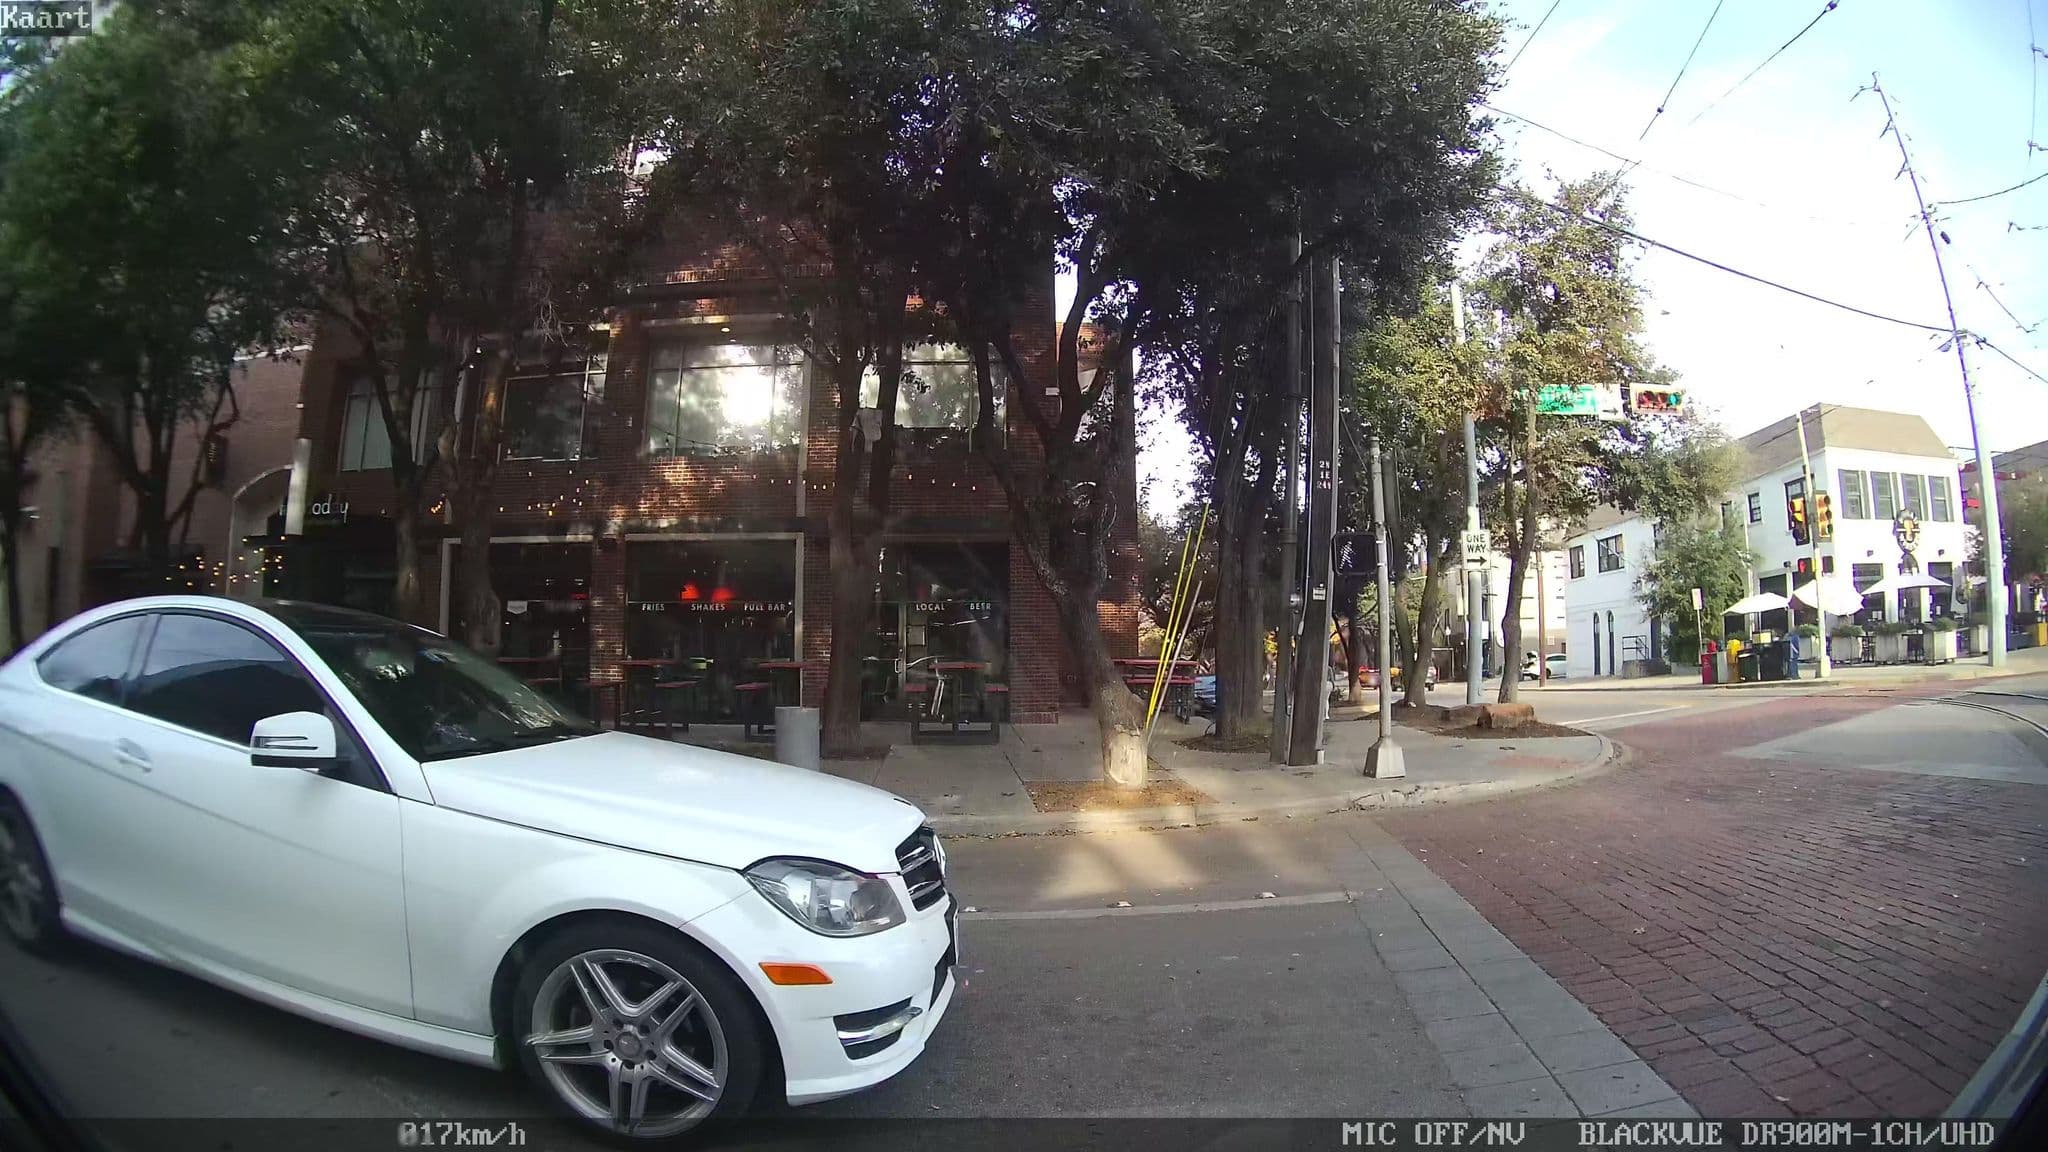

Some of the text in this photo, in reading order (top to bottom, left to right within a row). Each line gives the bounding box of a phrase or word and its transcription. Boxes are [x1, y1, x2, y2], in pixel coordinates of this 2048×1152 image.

[1466, 533, 1485, 543] ONE
[1466, 544, 1487, 553] WAY
[641, 603, 665, 611] FRIES
[690, 603, 726, 611] SHAKES
[743, 603, 786, 611] FULL BAR
[915, 602, 945, 611] LOCAL
[970, 602, 992, 610] BEER
